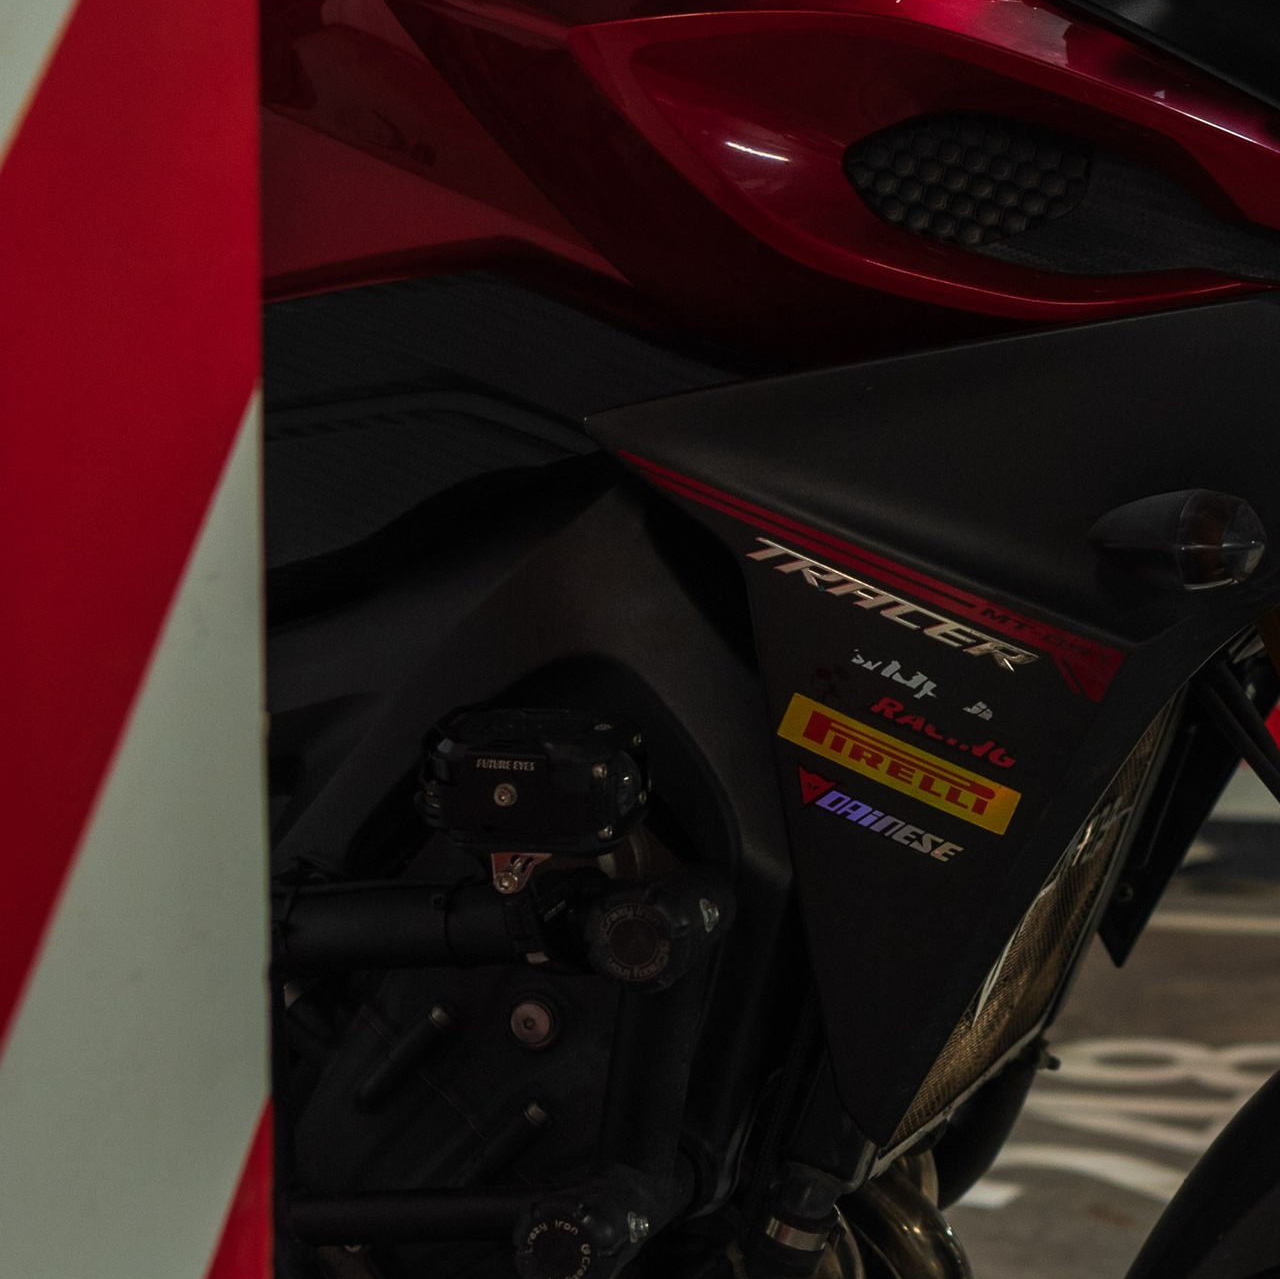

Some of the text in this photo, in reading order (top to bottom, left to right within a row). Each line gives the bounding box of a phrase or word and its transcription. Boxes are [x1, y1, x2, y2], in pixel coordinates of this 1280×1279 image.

[746, 537, 1042, 672] TRACER
[476, 758, 535, 771] FUTURE EYES
[803, 710, 996, 815] PIRELLI
[815, 790, 964, 862] DAINESE
